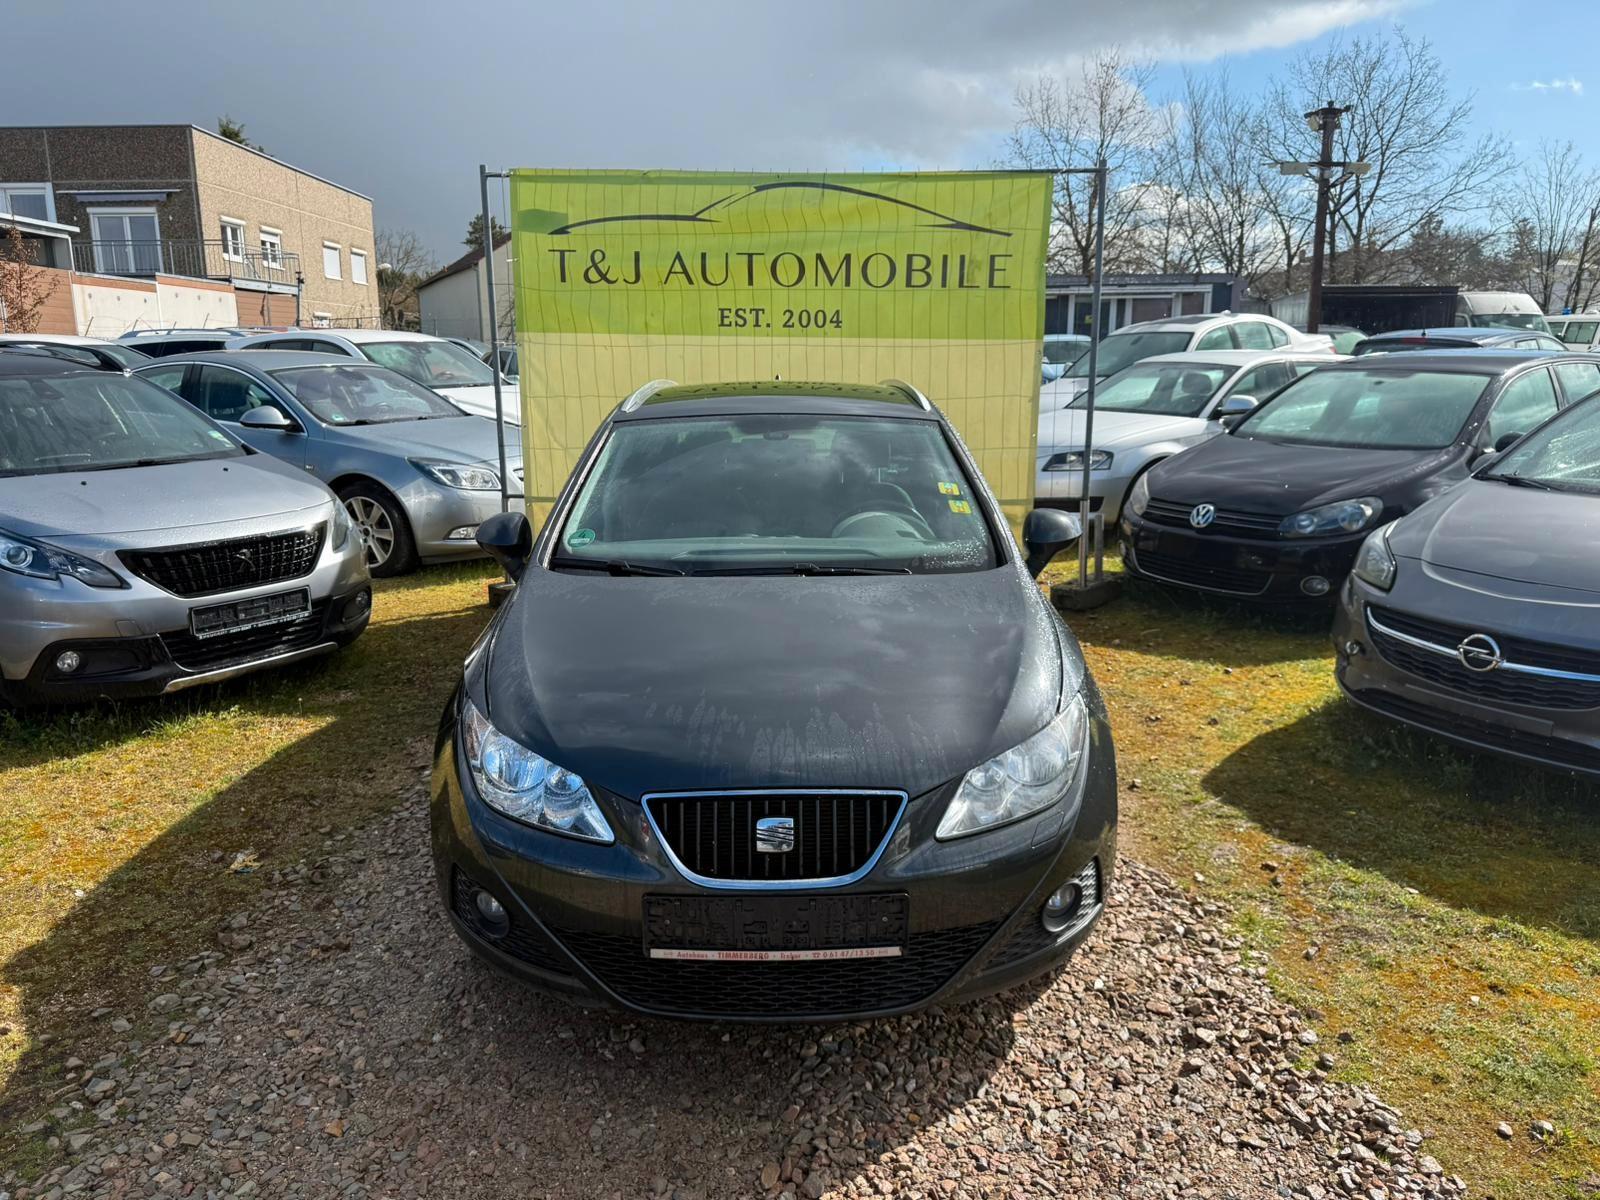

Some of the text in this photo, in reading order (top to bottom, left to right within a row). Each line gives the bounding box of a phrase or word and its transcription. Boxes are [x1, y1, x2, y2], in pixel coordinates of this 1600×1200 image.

[548, 249, 1013, 289] T&J AUTOMOBILE
[718, 307, 843, 329] EST. 2004
